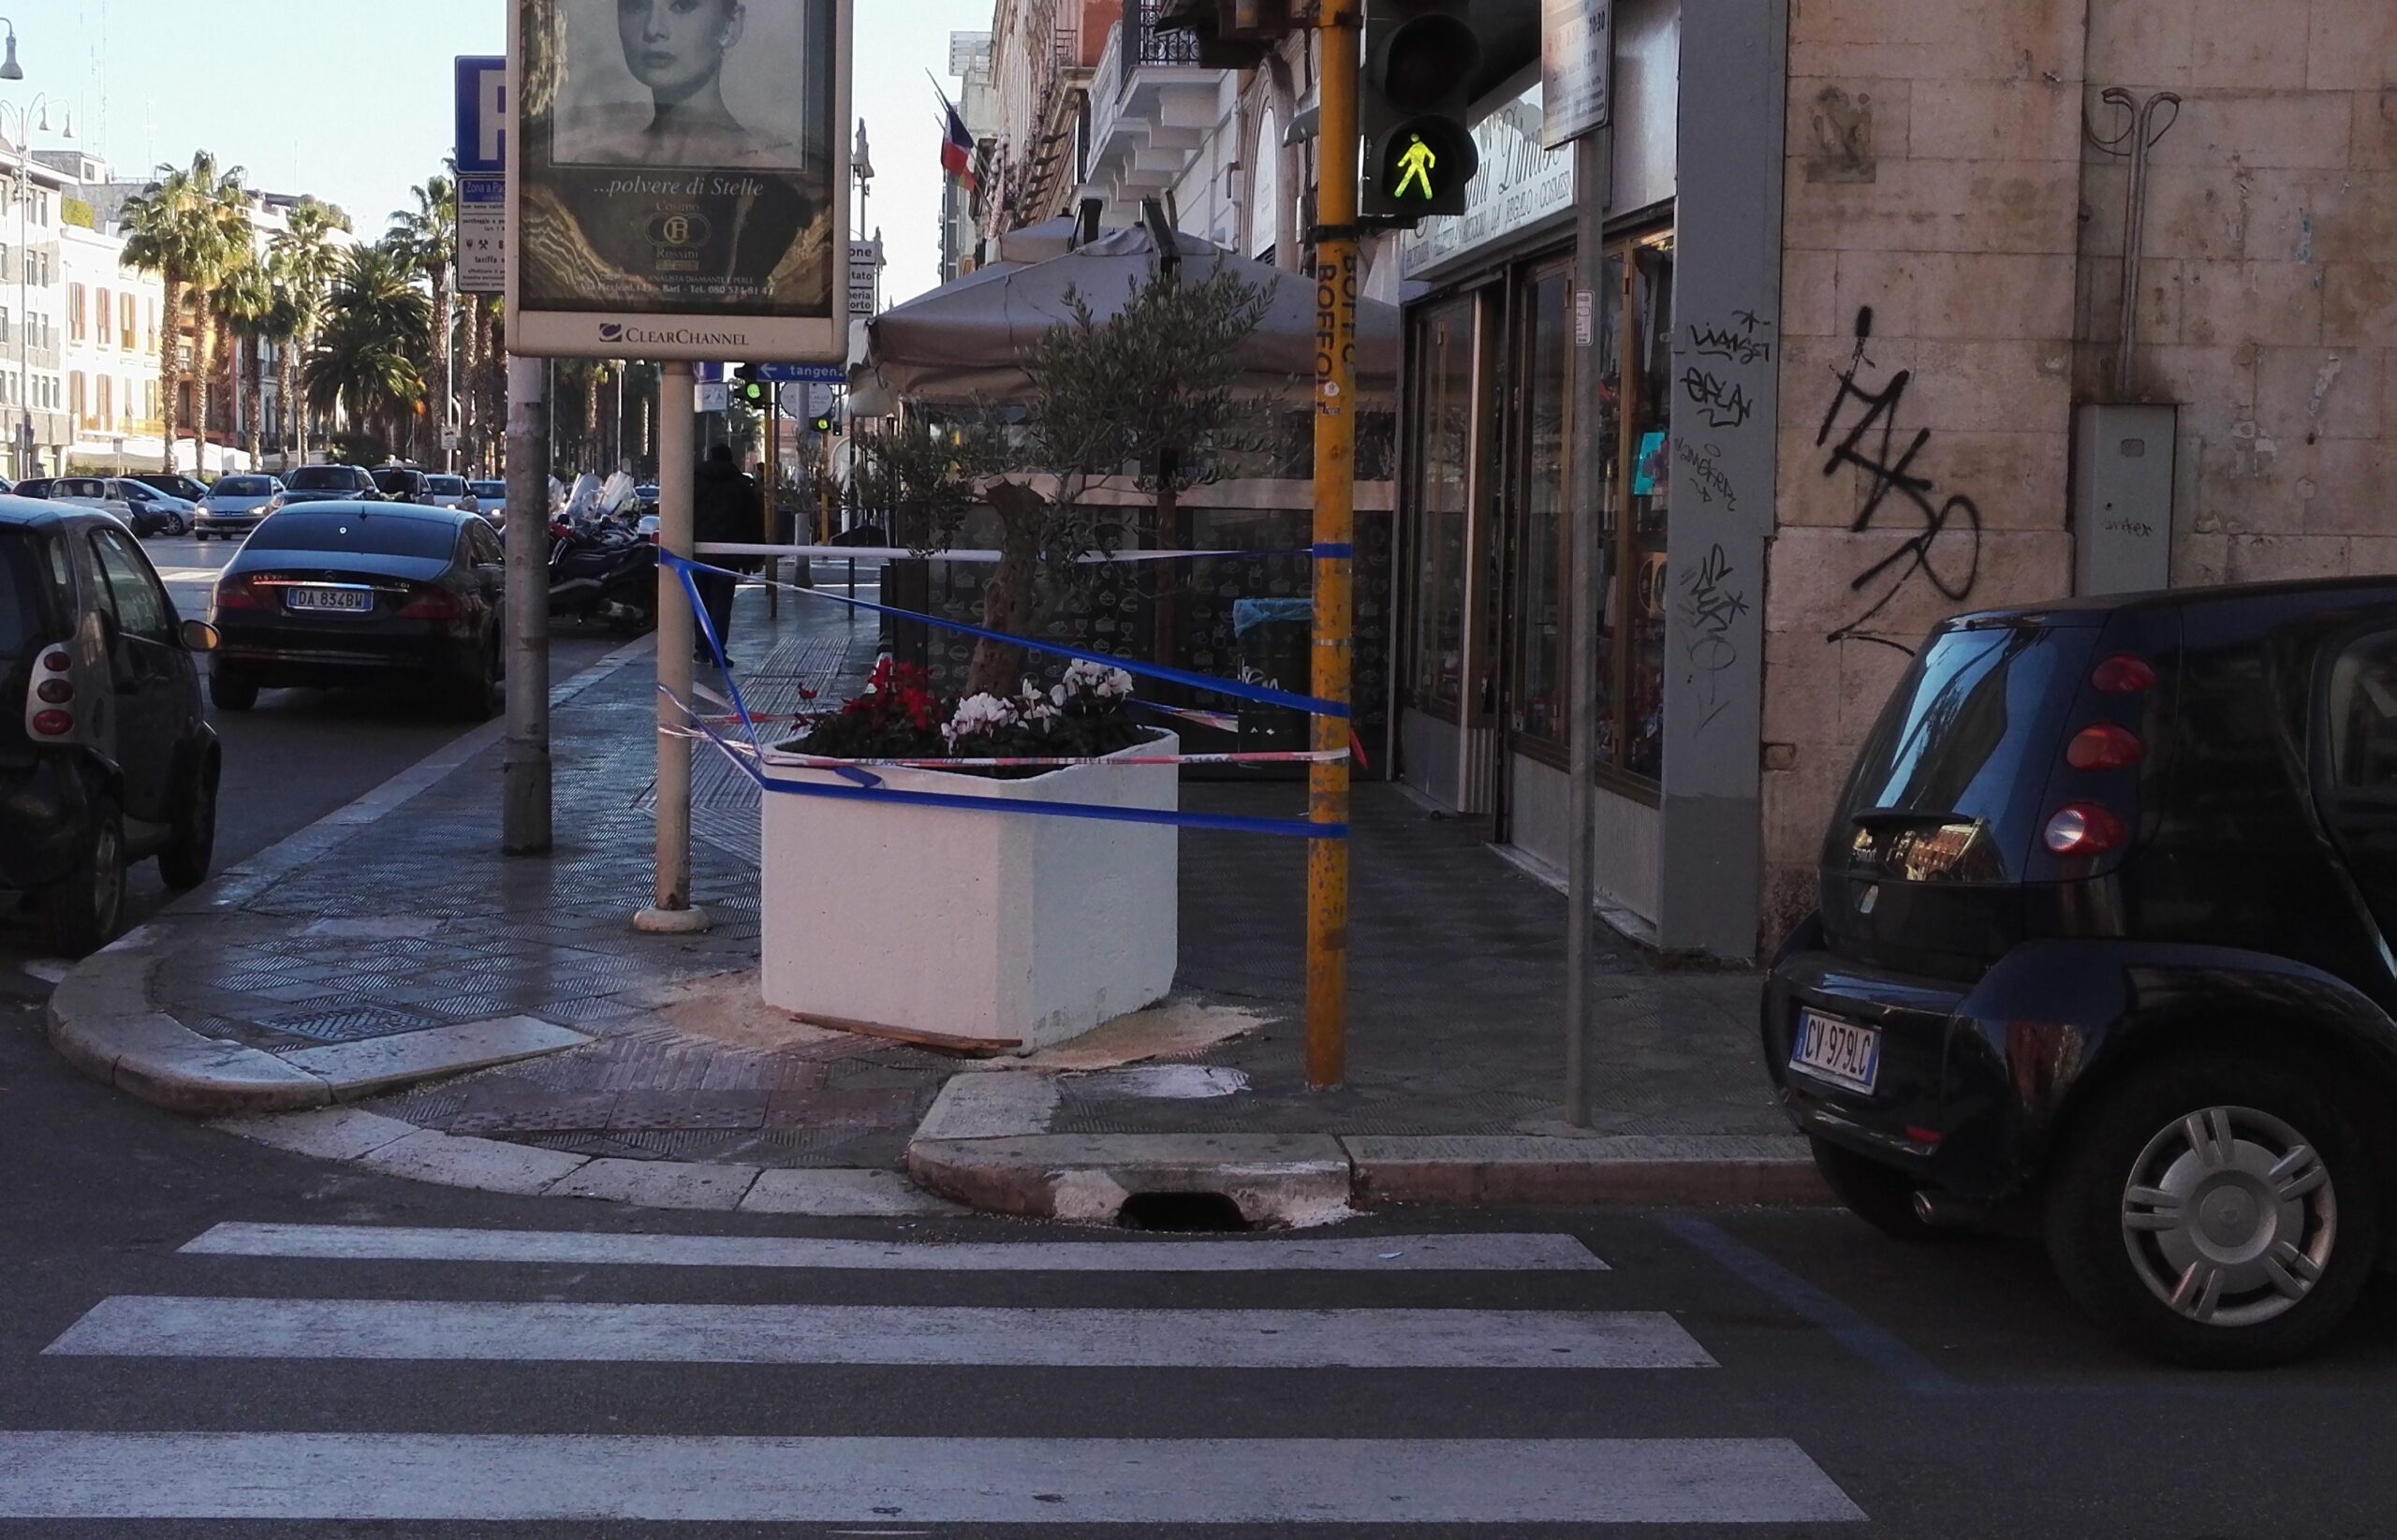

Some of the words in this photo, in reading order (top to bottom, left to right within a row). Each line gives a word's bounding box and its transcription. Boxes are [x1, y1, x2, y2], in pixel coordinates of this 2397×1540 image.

[465, 182, 485, 193] Zona
[686, 178, 704, 195] di
[712, 178, 763, 196] Stelle
[656, 245, 699, 258] Rossini
[663, 284, 681, 293] Bari
[691, 285, 705, 293] Tel.
[708, 285, 726, 294] 080
[298, 591, 316, 606] DA
[320, 592, 364, 609] 834BW
[1804, 1019, 1825, 1062] CV
[1826, 1024, 1871, 1077] 979LC
